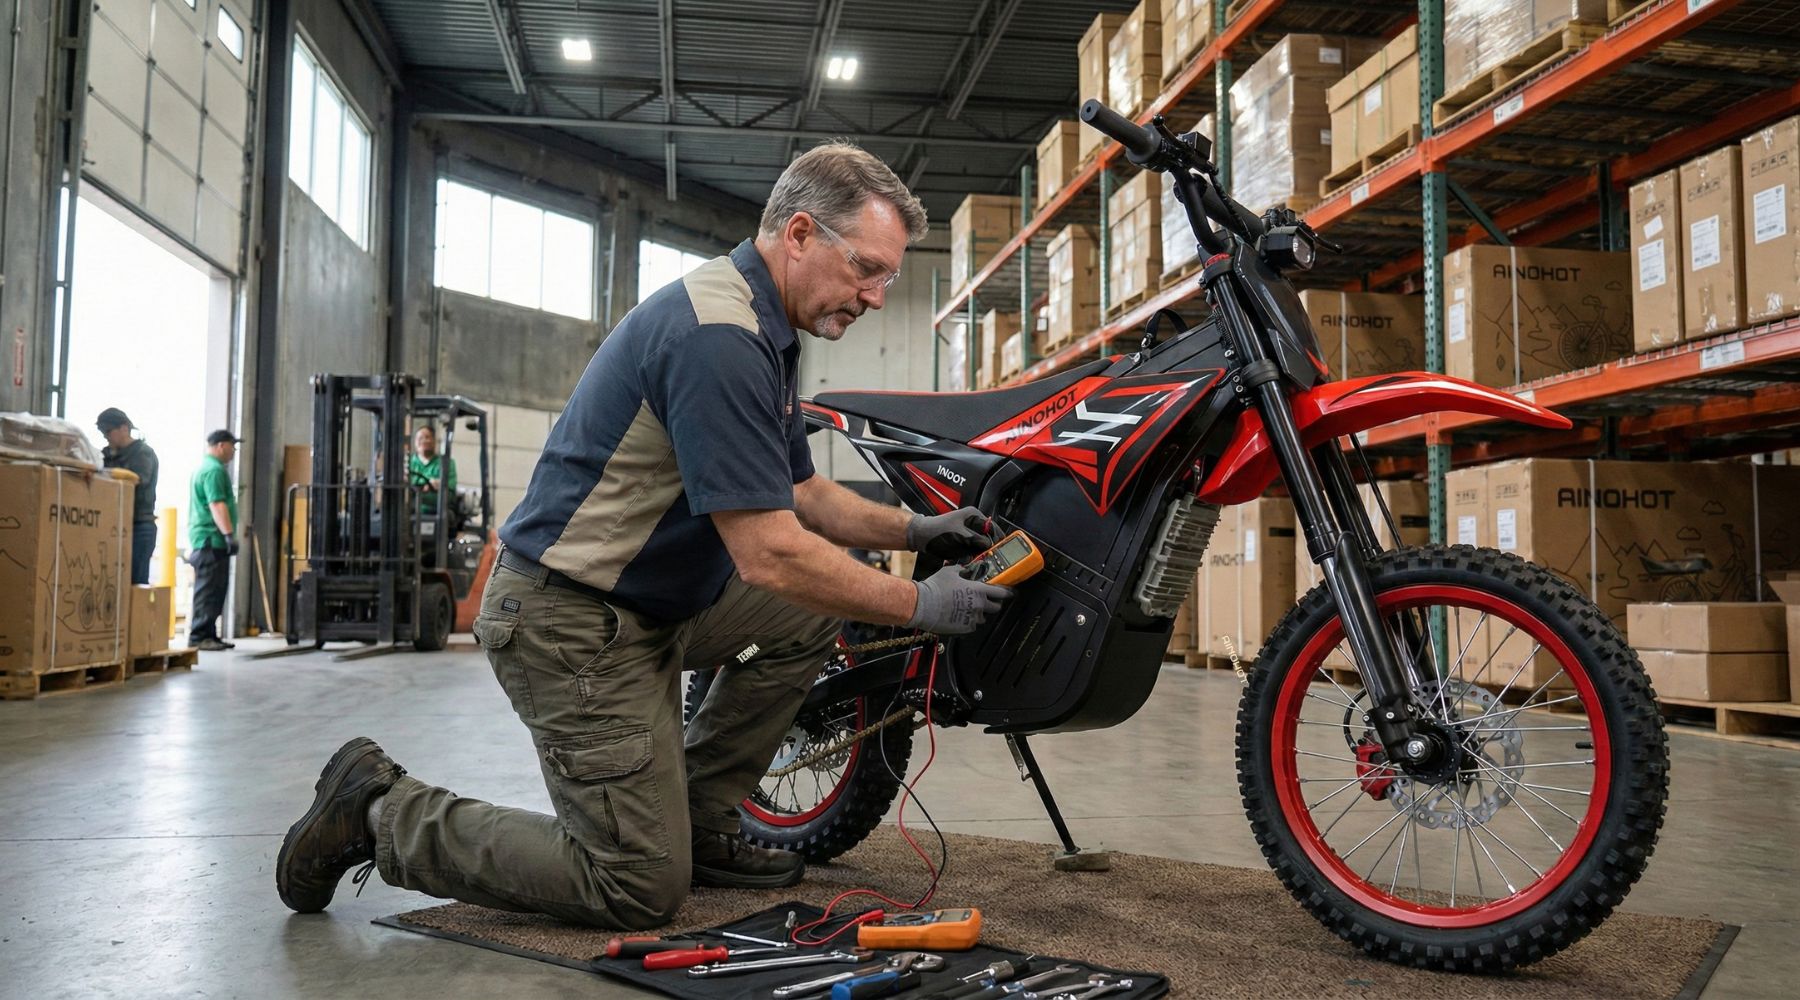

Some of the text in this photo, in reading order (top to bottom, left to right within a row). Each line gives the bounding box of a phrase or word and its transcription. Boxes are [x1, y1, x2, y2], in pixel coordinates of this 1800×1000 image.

[1493, 264, 1581, 281] AINOHOT
[1321, 314, 1394, 328] AINOHOT
[1557, 486, 1676, 509] AINOHOT
[49, 503, 101, 528] ANOHOT
